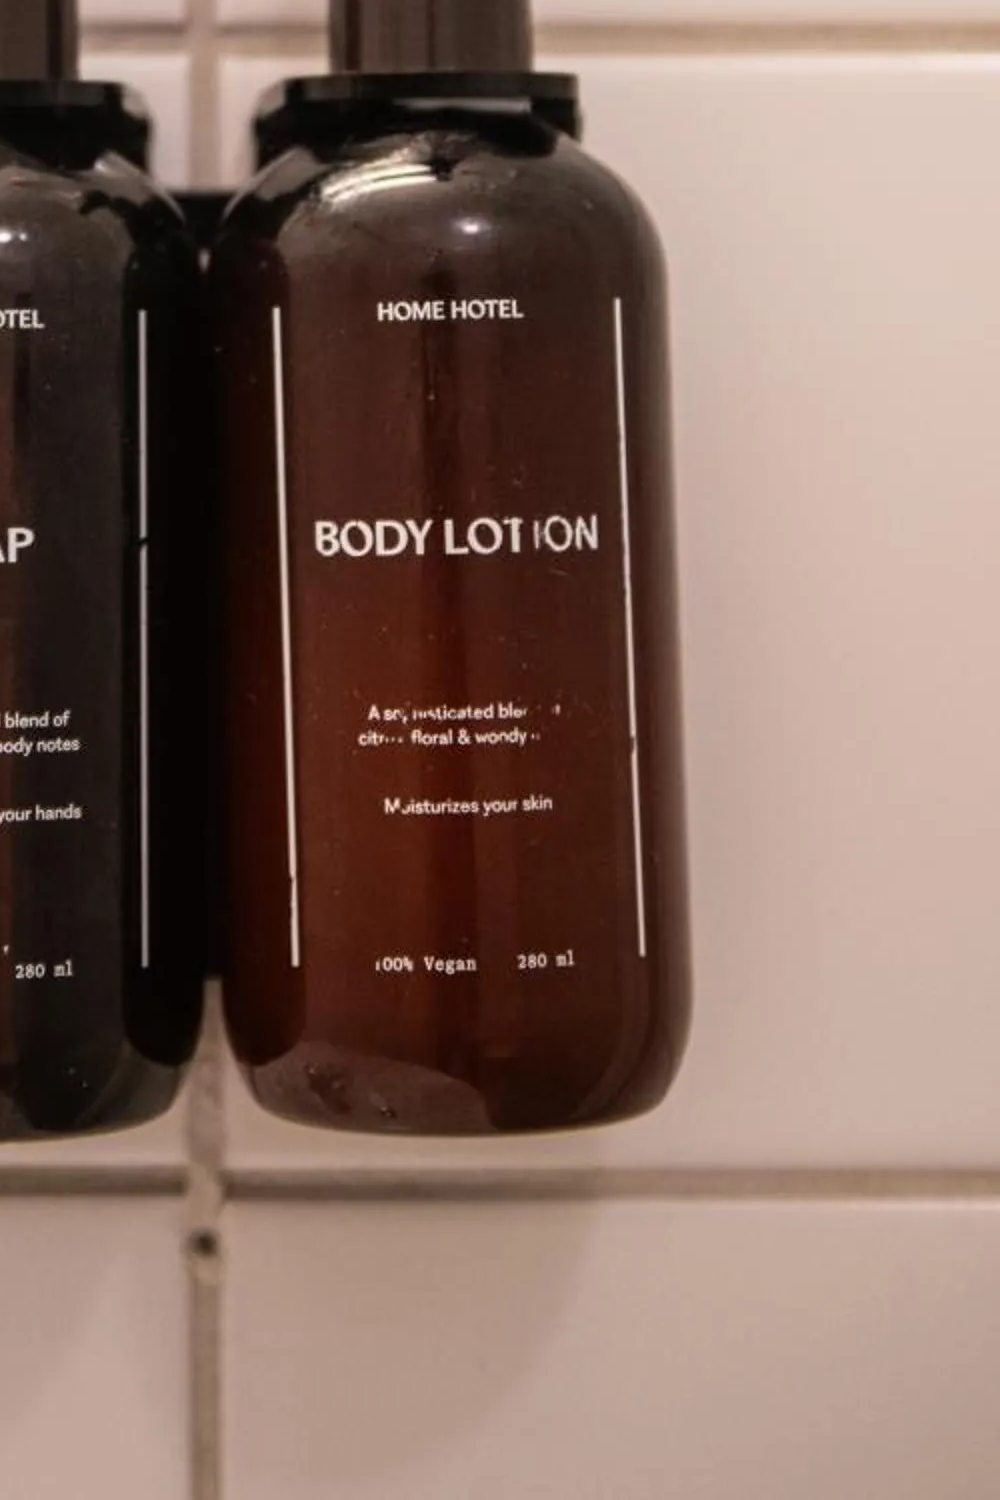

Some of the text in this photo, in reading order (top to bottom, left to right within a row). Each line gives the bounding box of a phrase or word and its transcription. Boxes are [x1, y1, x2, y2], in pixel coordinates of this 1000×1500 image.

[376, 299, 524, 322] HOME HOTEL
[314, 519, 433, 557] BODY
[4, 710, 48, 728] blend
[53, 709, 70, 726] of
[368, 704, 379, 720] A
[36, 737, 80, 752] notes
[411, 727, 452, 745] floral
[457, 728, 470, 744] &
[35, 803, 81, 820] hands
[482, 798, 517, 817] your
[522, 794, 553, 811] skin
[424, 955, 477, 974] Vegan
[517, 949, 574, 969] 280 ml
[15, 959, 73, 979] 280 ml
